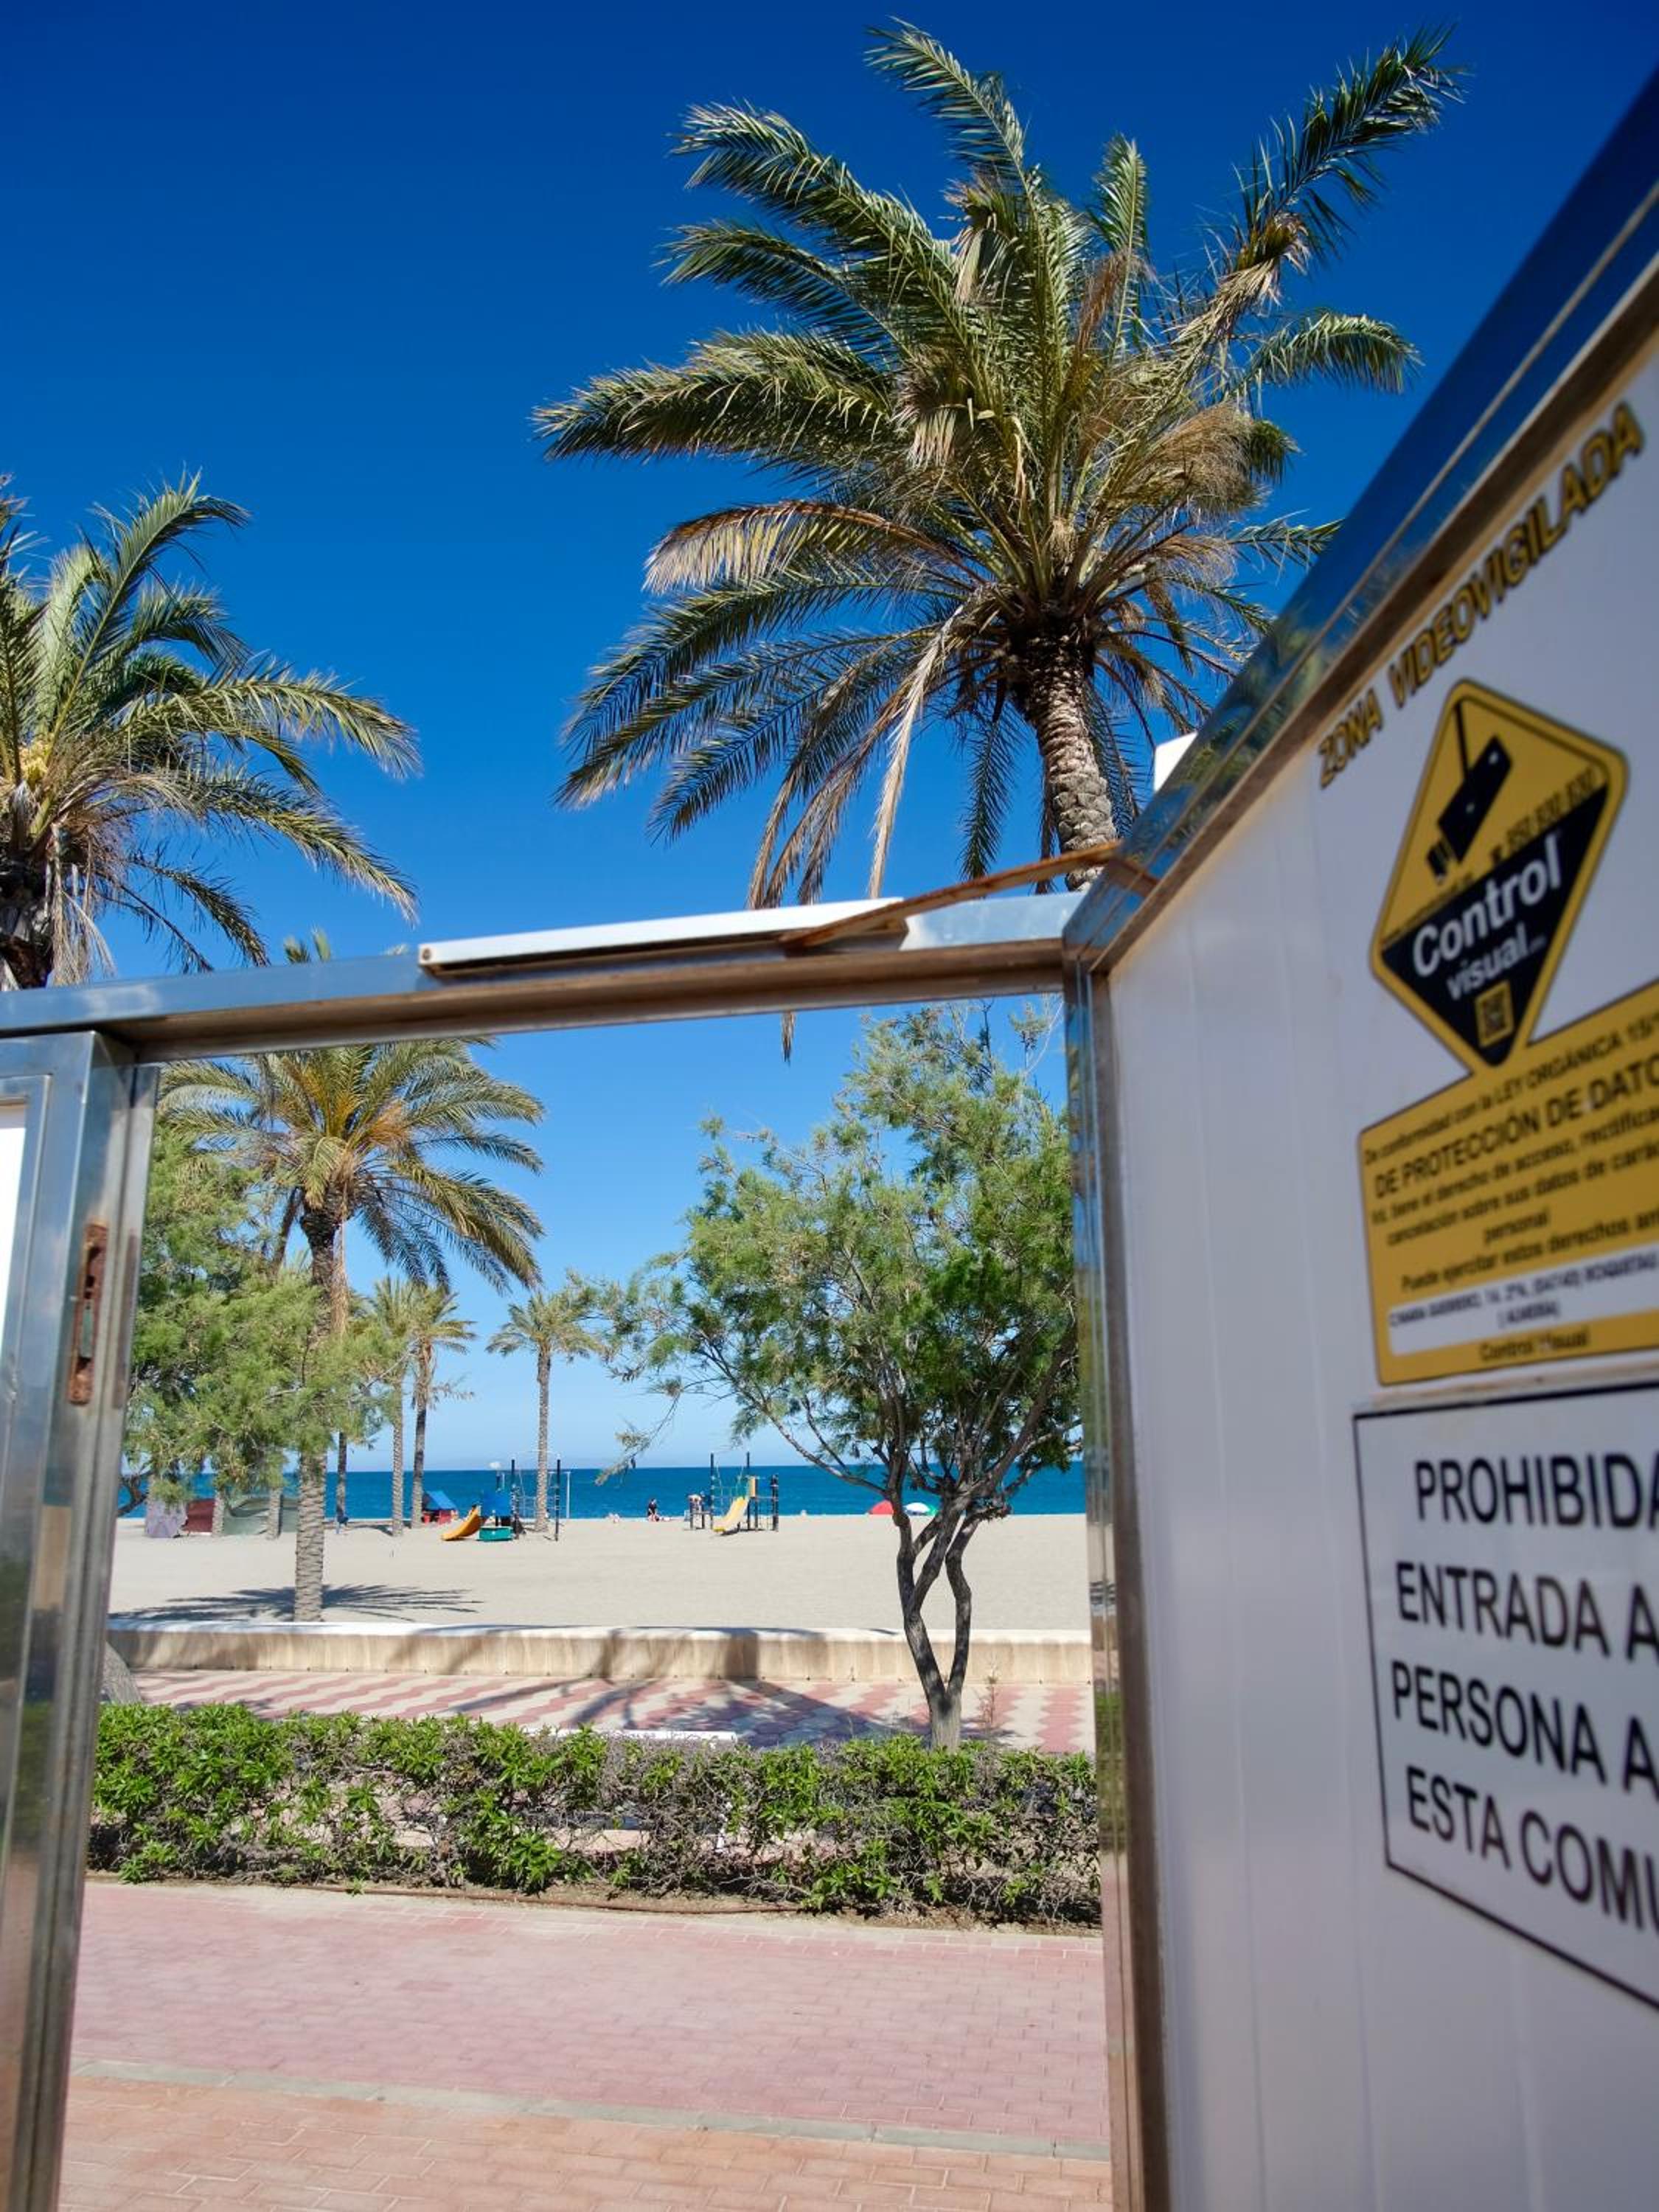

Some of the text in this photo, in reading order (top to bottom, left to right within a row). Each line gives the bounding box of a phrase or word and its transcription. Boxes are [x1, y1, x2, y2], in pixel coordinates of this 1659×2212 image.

[1318, 687, 1384, 790] ZONA
[1387, 401, 1645, 709] VIDEOVIGILADA
[1413, 833, 1562, 977] Control
[1375, 1167, 1399, 1199] DE
[1403, 1106, 1540, 1188] PROTECCIÓN
[1547, 1088, 1582, 1128] DE
[1548, 1219, 1630, 1252] derechos
[1413, 1448, 1659, 1531] PROHIBID
[1396, 1560, 1610, 1659] ENTRADA
[1391, 1659, 1607, 1786] PERSONA
[1405, 1765, 1512, 1871] ESTA
